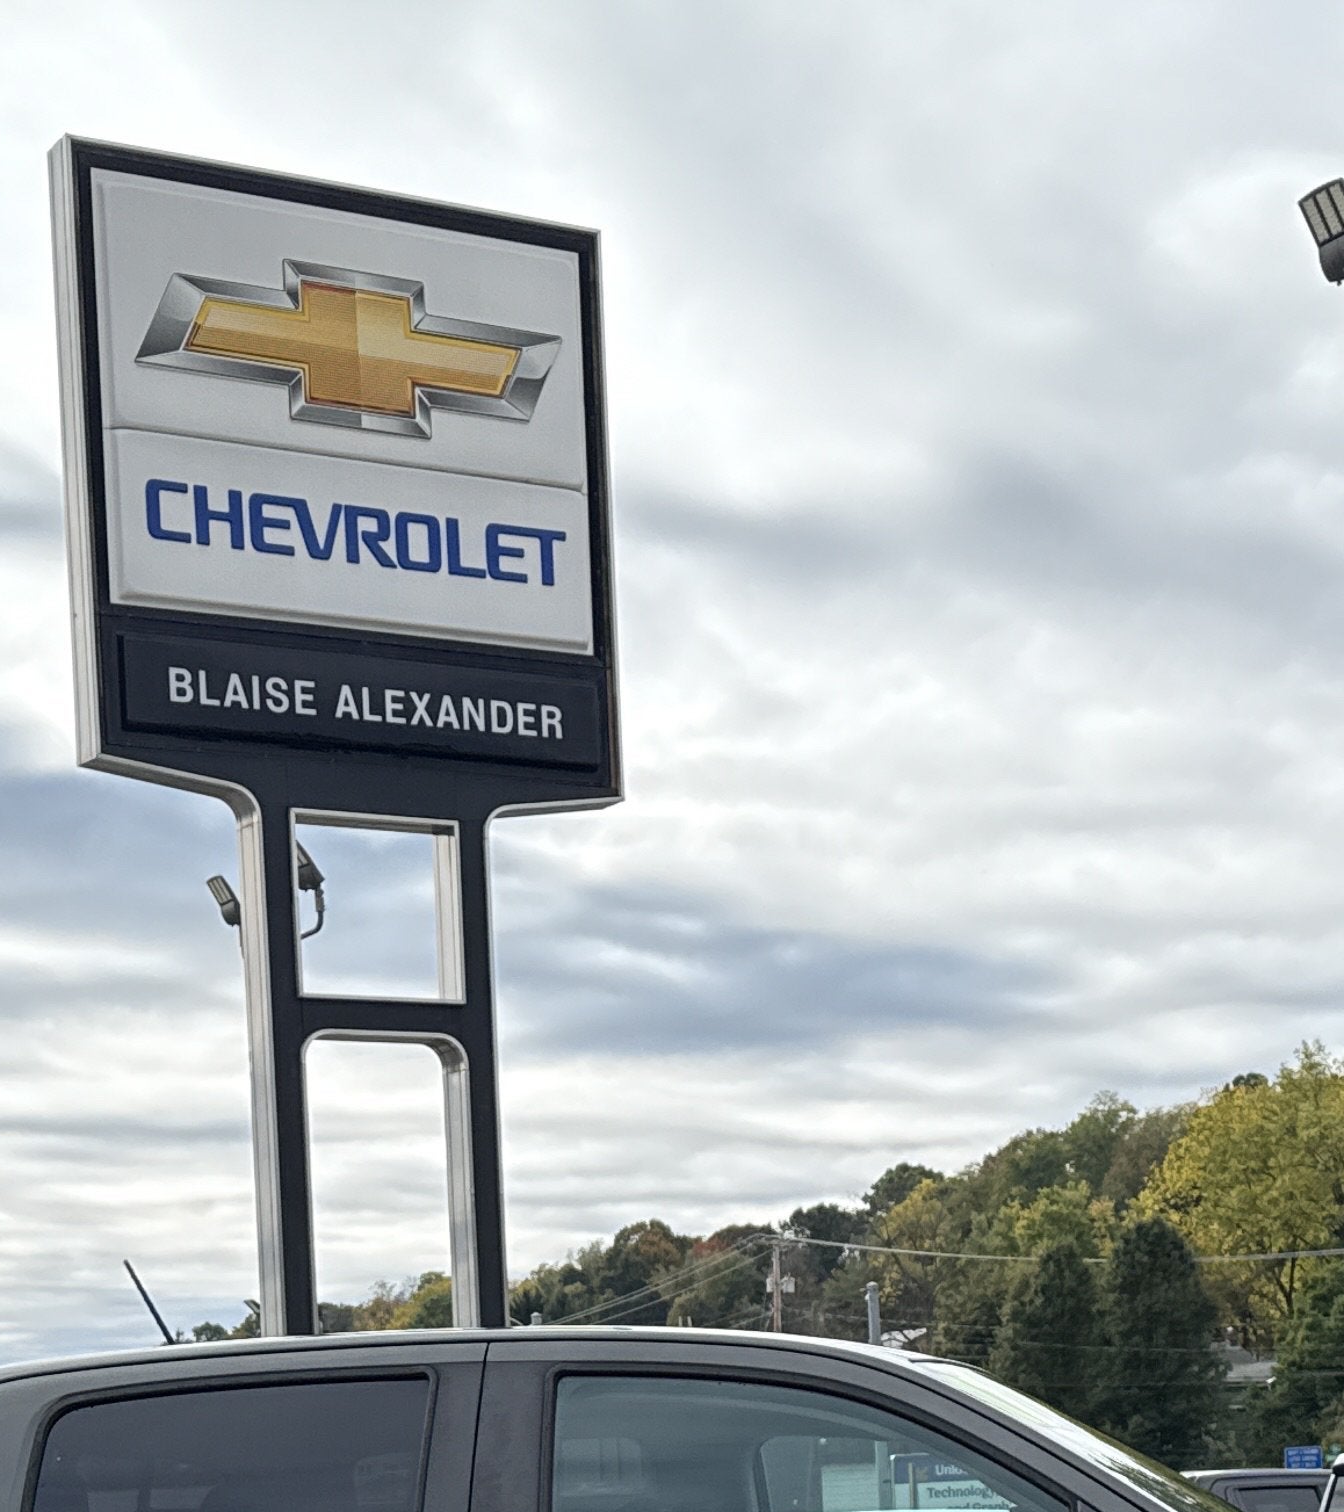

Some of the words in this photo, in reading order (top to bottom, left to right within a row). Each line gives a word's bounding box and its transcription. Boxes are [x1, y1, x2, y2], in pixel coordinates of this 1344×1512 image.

[145, 477, 567, 587] CHEVROLET
[167, 665, 317, 716] BLAISE
[334, 682, 565, 741] ALEXANDER
